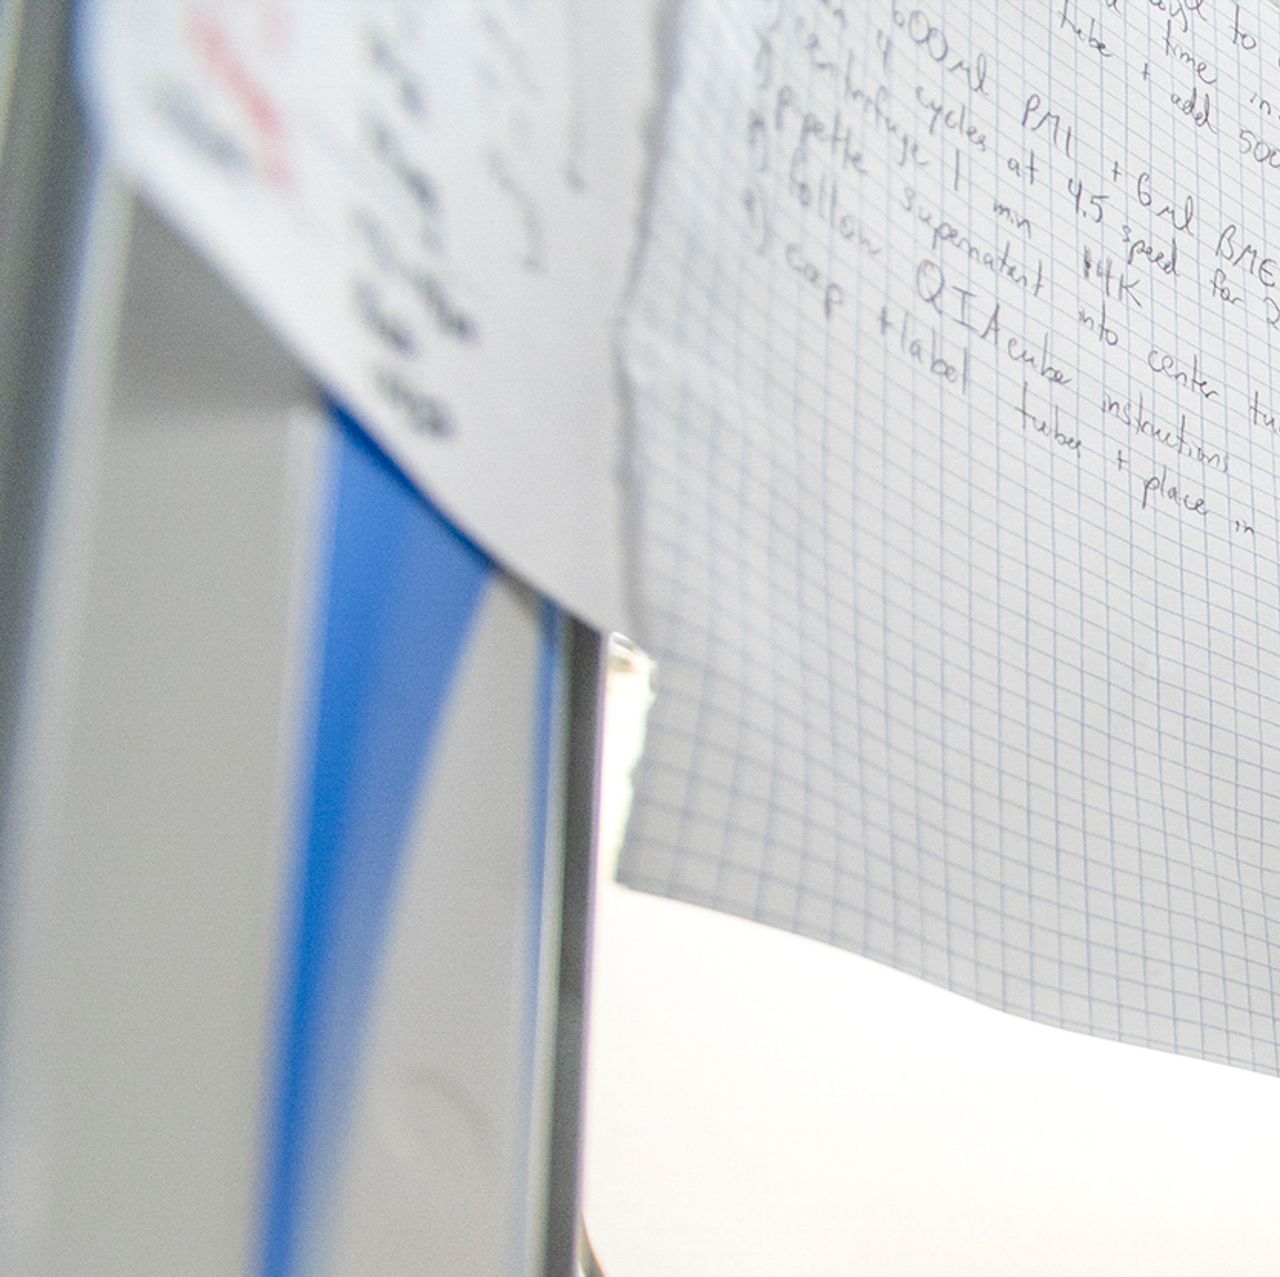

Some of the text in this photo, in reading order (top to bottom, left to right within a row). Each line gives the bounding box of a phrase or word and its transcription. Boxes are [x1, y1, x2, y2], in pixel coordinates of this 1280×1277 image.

[1058, 0, 1112, 58] tube
[1169, 87, 1218, 135] add
[1162, 19, 1217, 85] time
[1231, 5, 1257, 50] to
[915, 85, 987, 152] cycles
[1007, 149, 1039, 186] at
[1066, 177, 1109, 225] 4.5
[1122, 224, 1181, 278] speed
[993, 200, 1032, 240] min
[1111, 160, 1125, 183] +
[1215, 224, 1278, 288] BME
[901, 309, 969, 395] label
[1013, 380, 1083, 460] tubes
[1115, 449, 1129, 471] +
[1142, 464, 1210, 517] place
[1233, 517, 1257, 536] in
[1147, 350, 1219, 399] center
